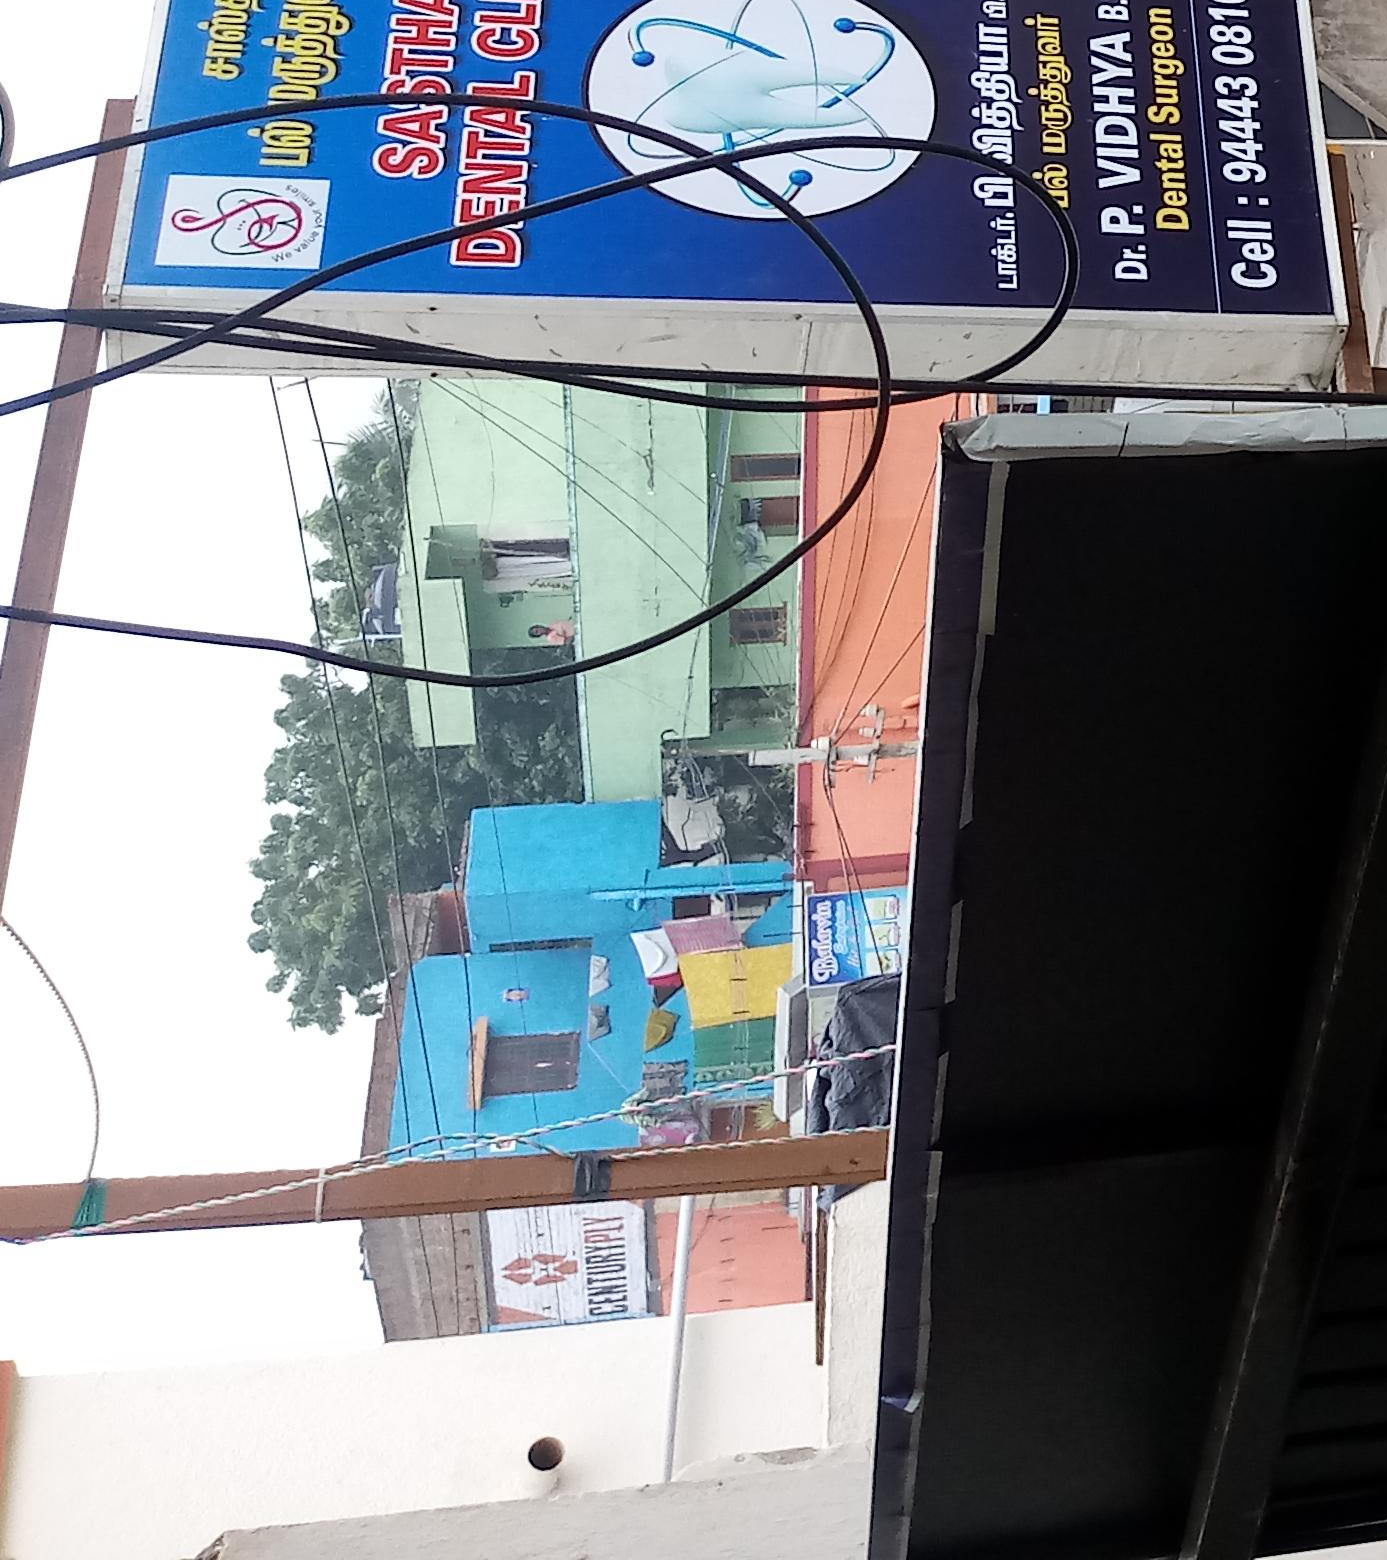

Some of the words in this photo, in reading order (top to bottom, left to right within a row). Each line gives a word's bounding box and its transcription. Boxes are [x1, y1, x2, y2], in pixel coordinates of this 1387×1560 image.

[970, 23, 1024, 164] வித்தியா
[1024, 14, 1072, 153] மருத்துவர்
[1089, 32, 1141, 189] VIDHYA
[1147, 7, 1184, 124] Surgeon
[248, 121, 313, 167] பல்
[450, 71, 535, 267] DENTAL
[1215, 76, 1267, 183] 94443
[1100, 204, 1145, 235] P.
[1150, 134, 1189, 231] Dental
[989, 213, 1018, 289] டாக்டர்.
[1115, 244, 1148, 281] Dr.
[1227, 220, 1277, 289] Cell
[583, 1216, 628, 1316] CENTURYPLY
